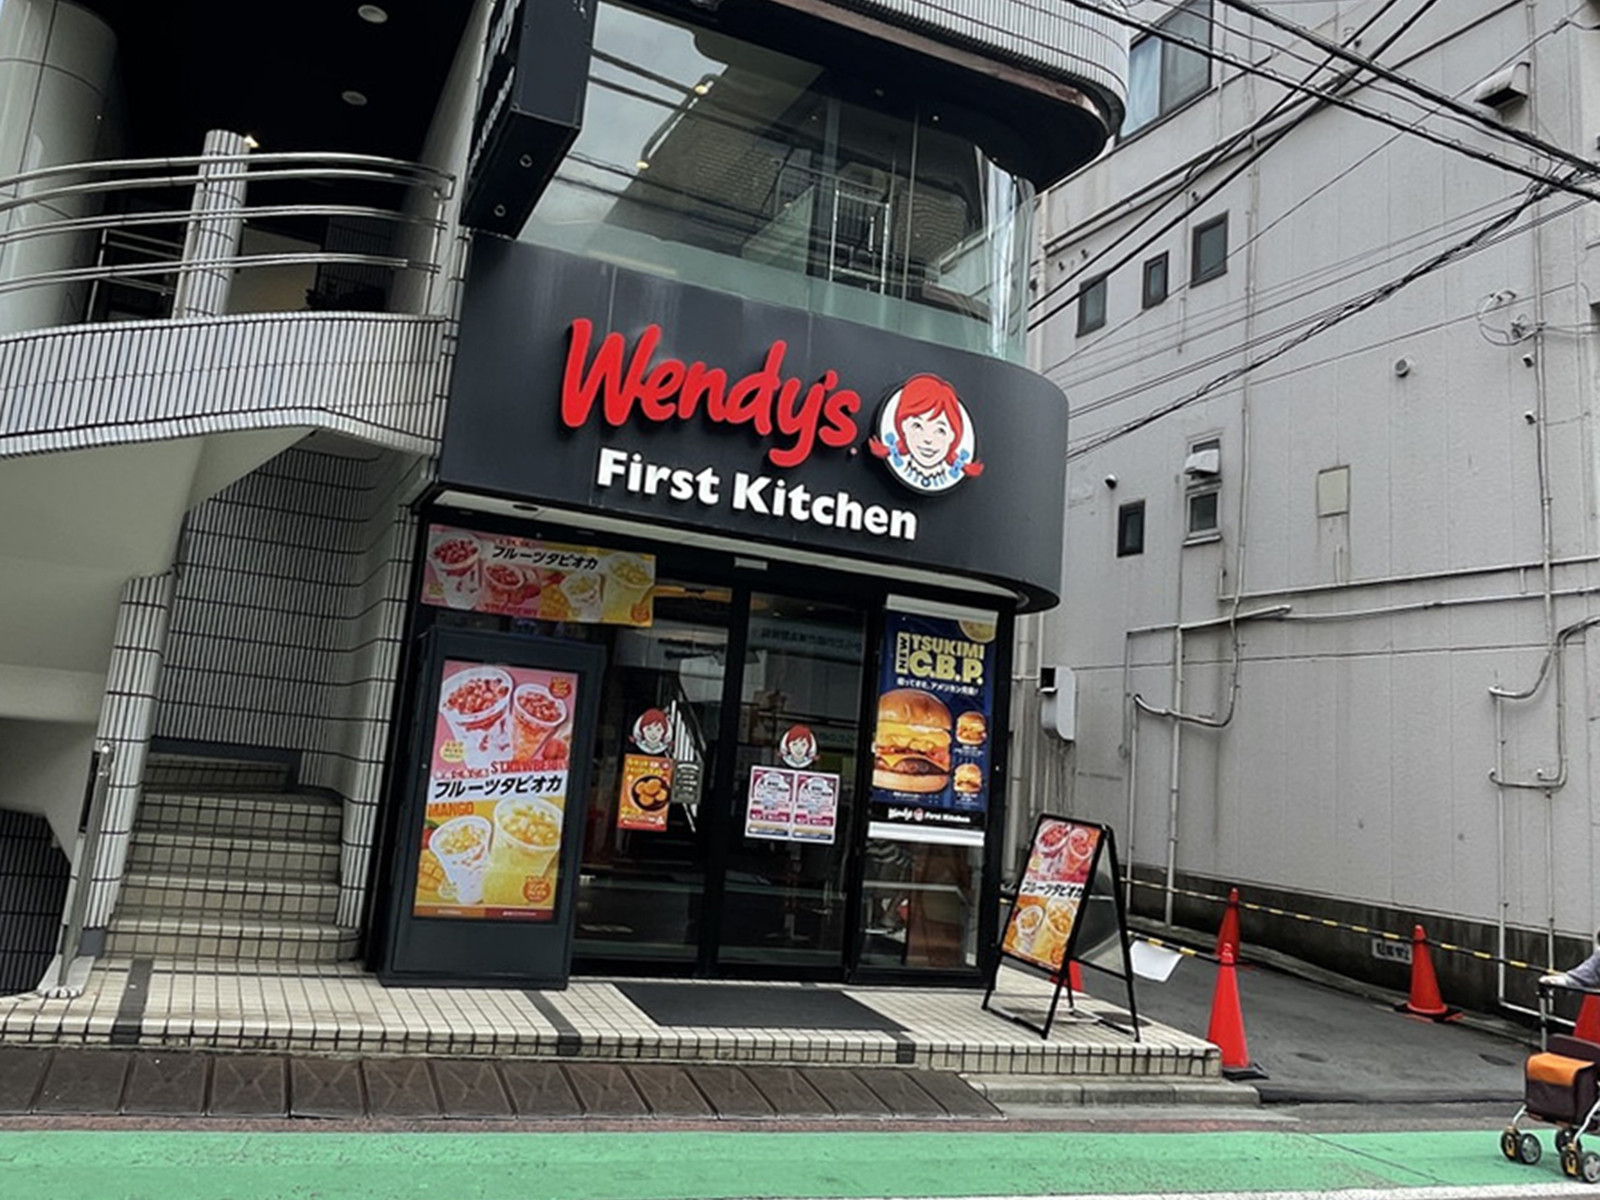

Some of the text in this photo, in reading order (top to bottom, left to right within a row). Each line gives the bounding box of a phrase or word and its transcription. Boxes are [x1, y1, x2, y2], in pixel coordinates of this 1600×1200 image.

[561, 318, 861, 467] Wendy's
[597, 446, 918, 540] First Kitchen
[491, 545, 599, 571] フルーツタピオカ
[911, 634, 985, 660] TSUKIMI
[490, 757, 570, 774] STRAWBERRY
[434, 774, 562, 799] フルーツタピオカ
[427, 801, 475, 818] MANGO
